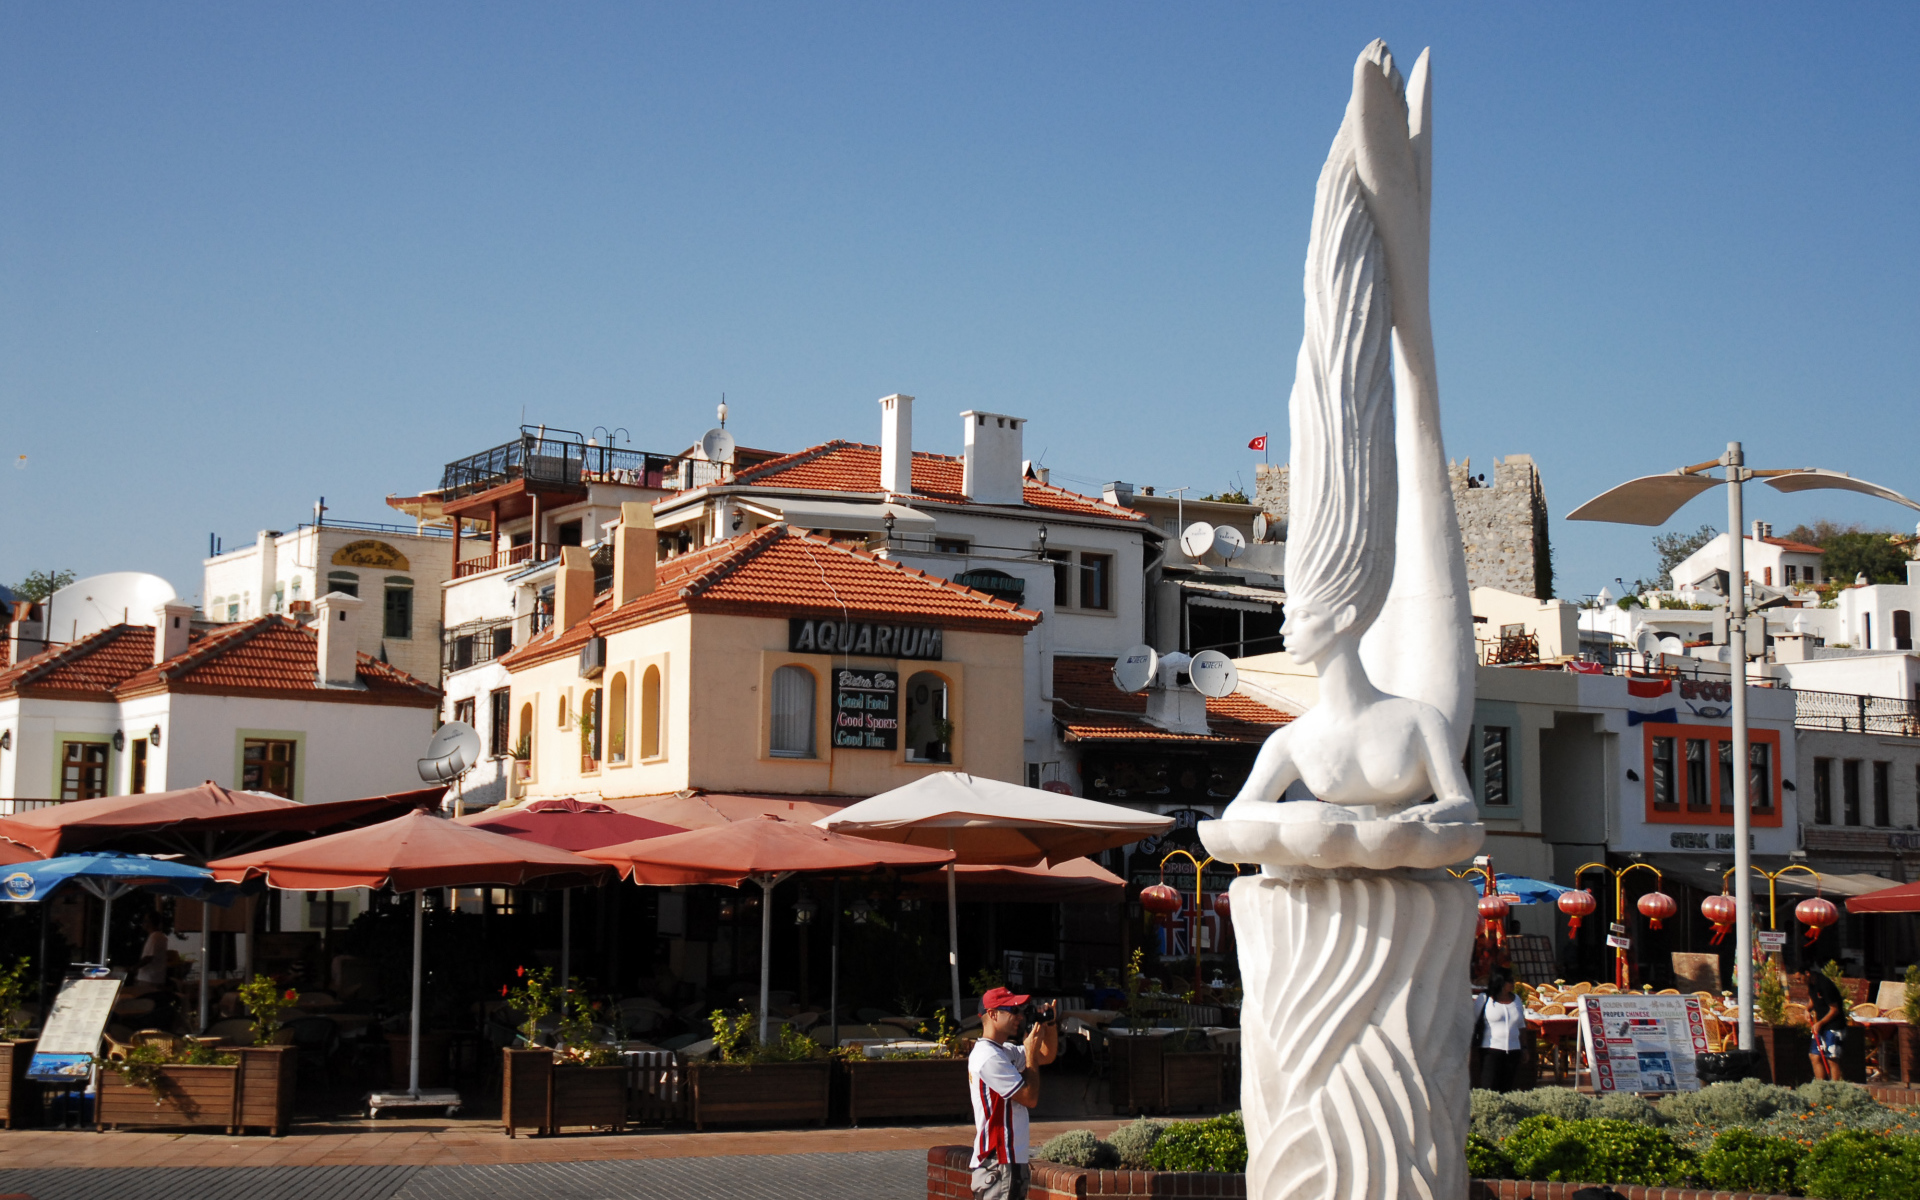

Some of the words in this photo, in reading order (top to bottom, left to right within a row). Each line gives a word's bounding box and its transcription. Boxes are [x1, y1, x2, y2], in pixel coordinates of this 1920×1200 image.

[953, 574, 1024, 591] AQUARIUM
[795, 620, 941, 657] AQUARIUM
[874, 673, 896, 688] Bar
[838, 693, 864, 709] Good
[866, 694, 889, 710] Food
[838, 711, 864, 728] Good
[837, 730, 863, 747] Good
[1670, 832, 1710, 848] STEAK
